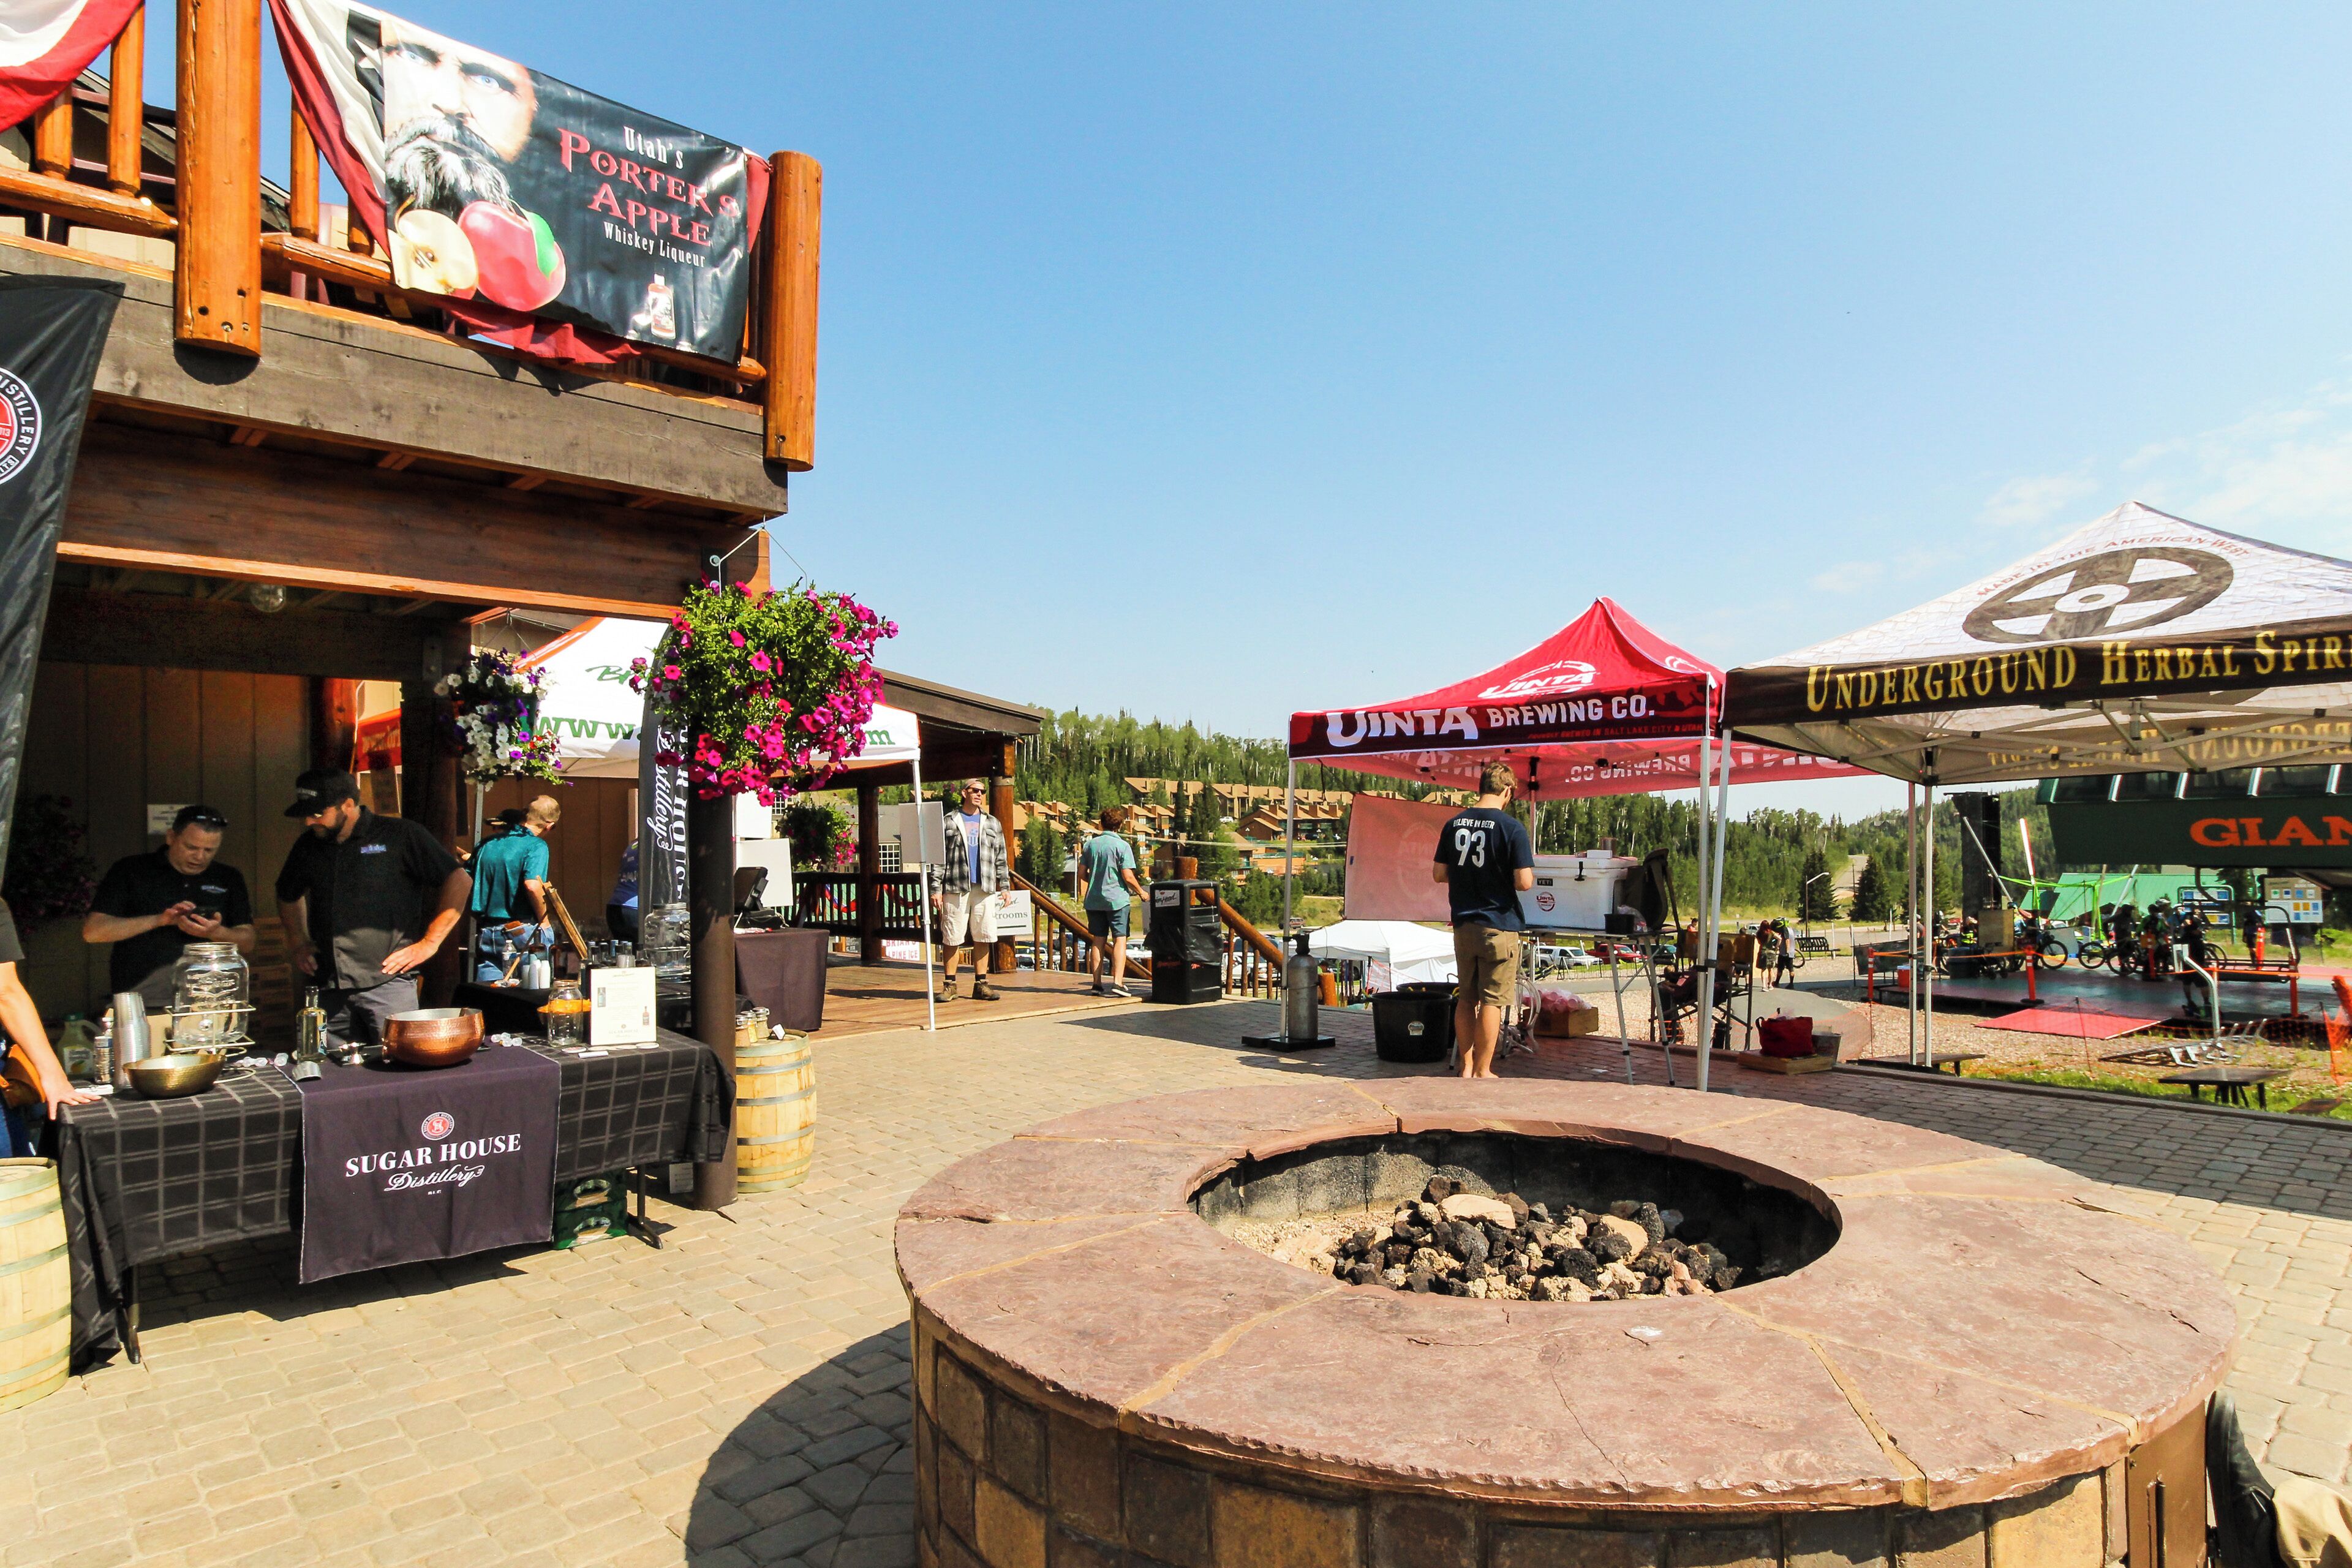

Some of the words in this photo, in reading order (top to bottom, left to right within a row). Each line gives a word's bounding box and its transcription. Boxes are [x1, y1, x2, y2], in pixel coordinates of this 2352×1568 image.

[623, 125, 683, 169] Utah's
[557, 127, 741, 218] PORTERS
[587, 183, 712, 247] APPLE
[603, 221, 654, 255] Whiskey
[659, 239, 706, 268] Liqueur
[1977, 573, 2023, 596] MADE
[2029, 560, 2055, 572] IN
[2064, 547, 2097, 560] THE
[2105, 536, 2206, 548] AMERICAN
[2211, 538, 2249, 557] WEST
[1478, 672, 1596, 699] UINTA
[1807, 646, 2077, 712] UNDERGROUND
[2100, 641, 2241, 685] HERBAL
[1326, 706, 1479, 747] UINTA
[1486, 699, 1603, 727] BREWING
[1611, 694, 1655, 719] CO.
[1626, 725, 1648, 734] LAKE
[1651, 725, 1672, 733] CITY
[1453, 818, 1474, 827] BELIEVE
[1481, 820, 1495, 829] BEER
[1455, 828, 1486, 868] 93
[345, 1147, 432, 1177] SUGAR
[439, 1133, 521, 1163] HOUSE
[383, 1164, 485, 1192] Distillery
